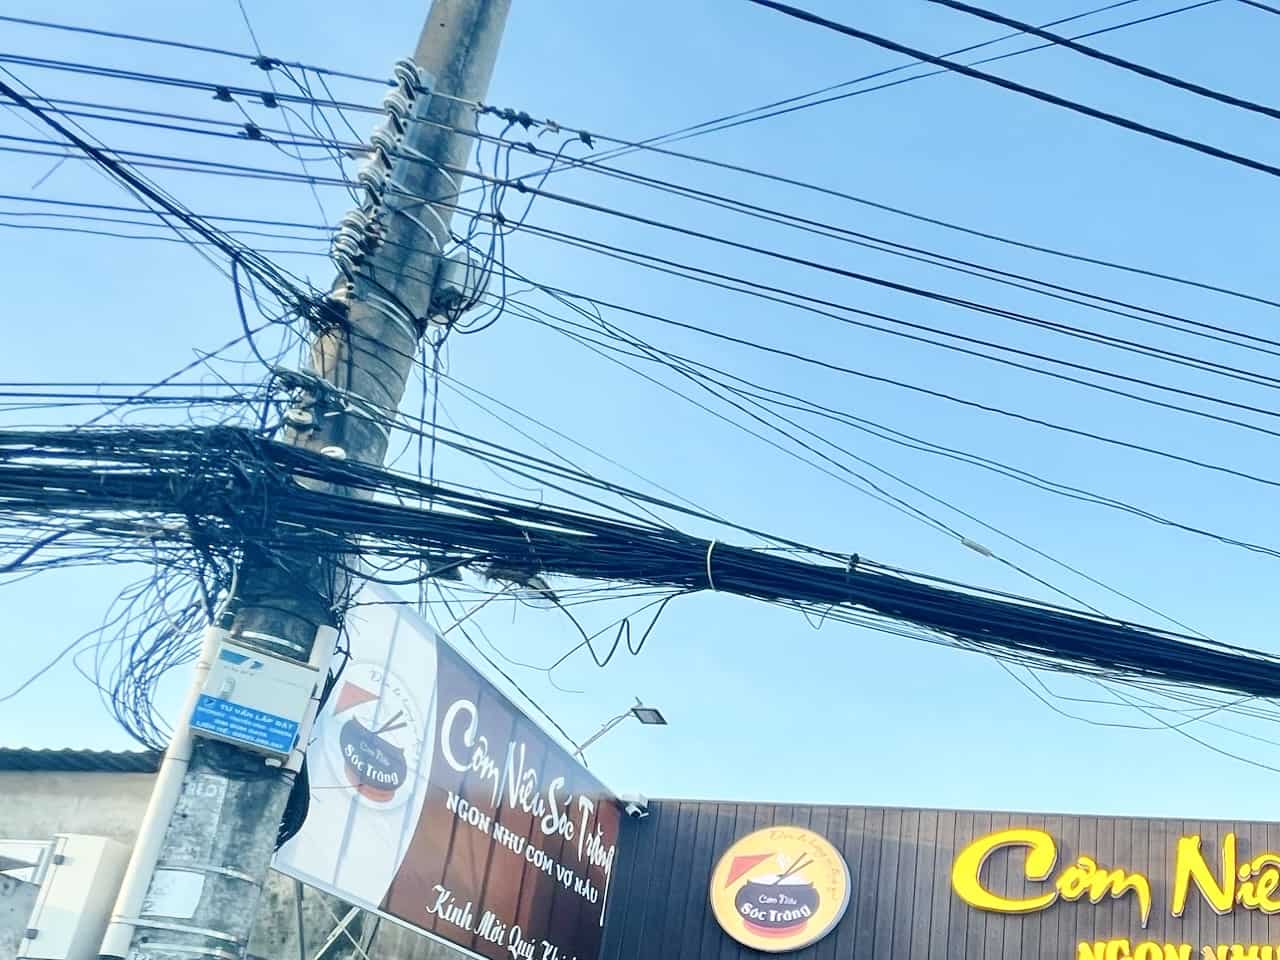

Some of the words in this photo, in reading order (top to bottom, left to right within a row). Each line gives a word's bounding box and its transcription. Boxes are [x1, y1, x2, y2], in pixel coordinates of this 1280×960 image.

[446, 791, 491, 835] NGON
[492, 821, 525, 856] NHƯ
[525, 843, 553, 877] CƠM
[556, 862, 573, 890] VỢ
[497, 740, 546, 817] Niêu
[541, 776, 575, 842] Sóc
[578, 794, 615, 928] Trăng
[952, 828, 1152, 929] Cơm
[425, 884, 474, 933] Kính
[474, 910, 507, 947] Mời
[741, 902, 768, 922] Sóc
